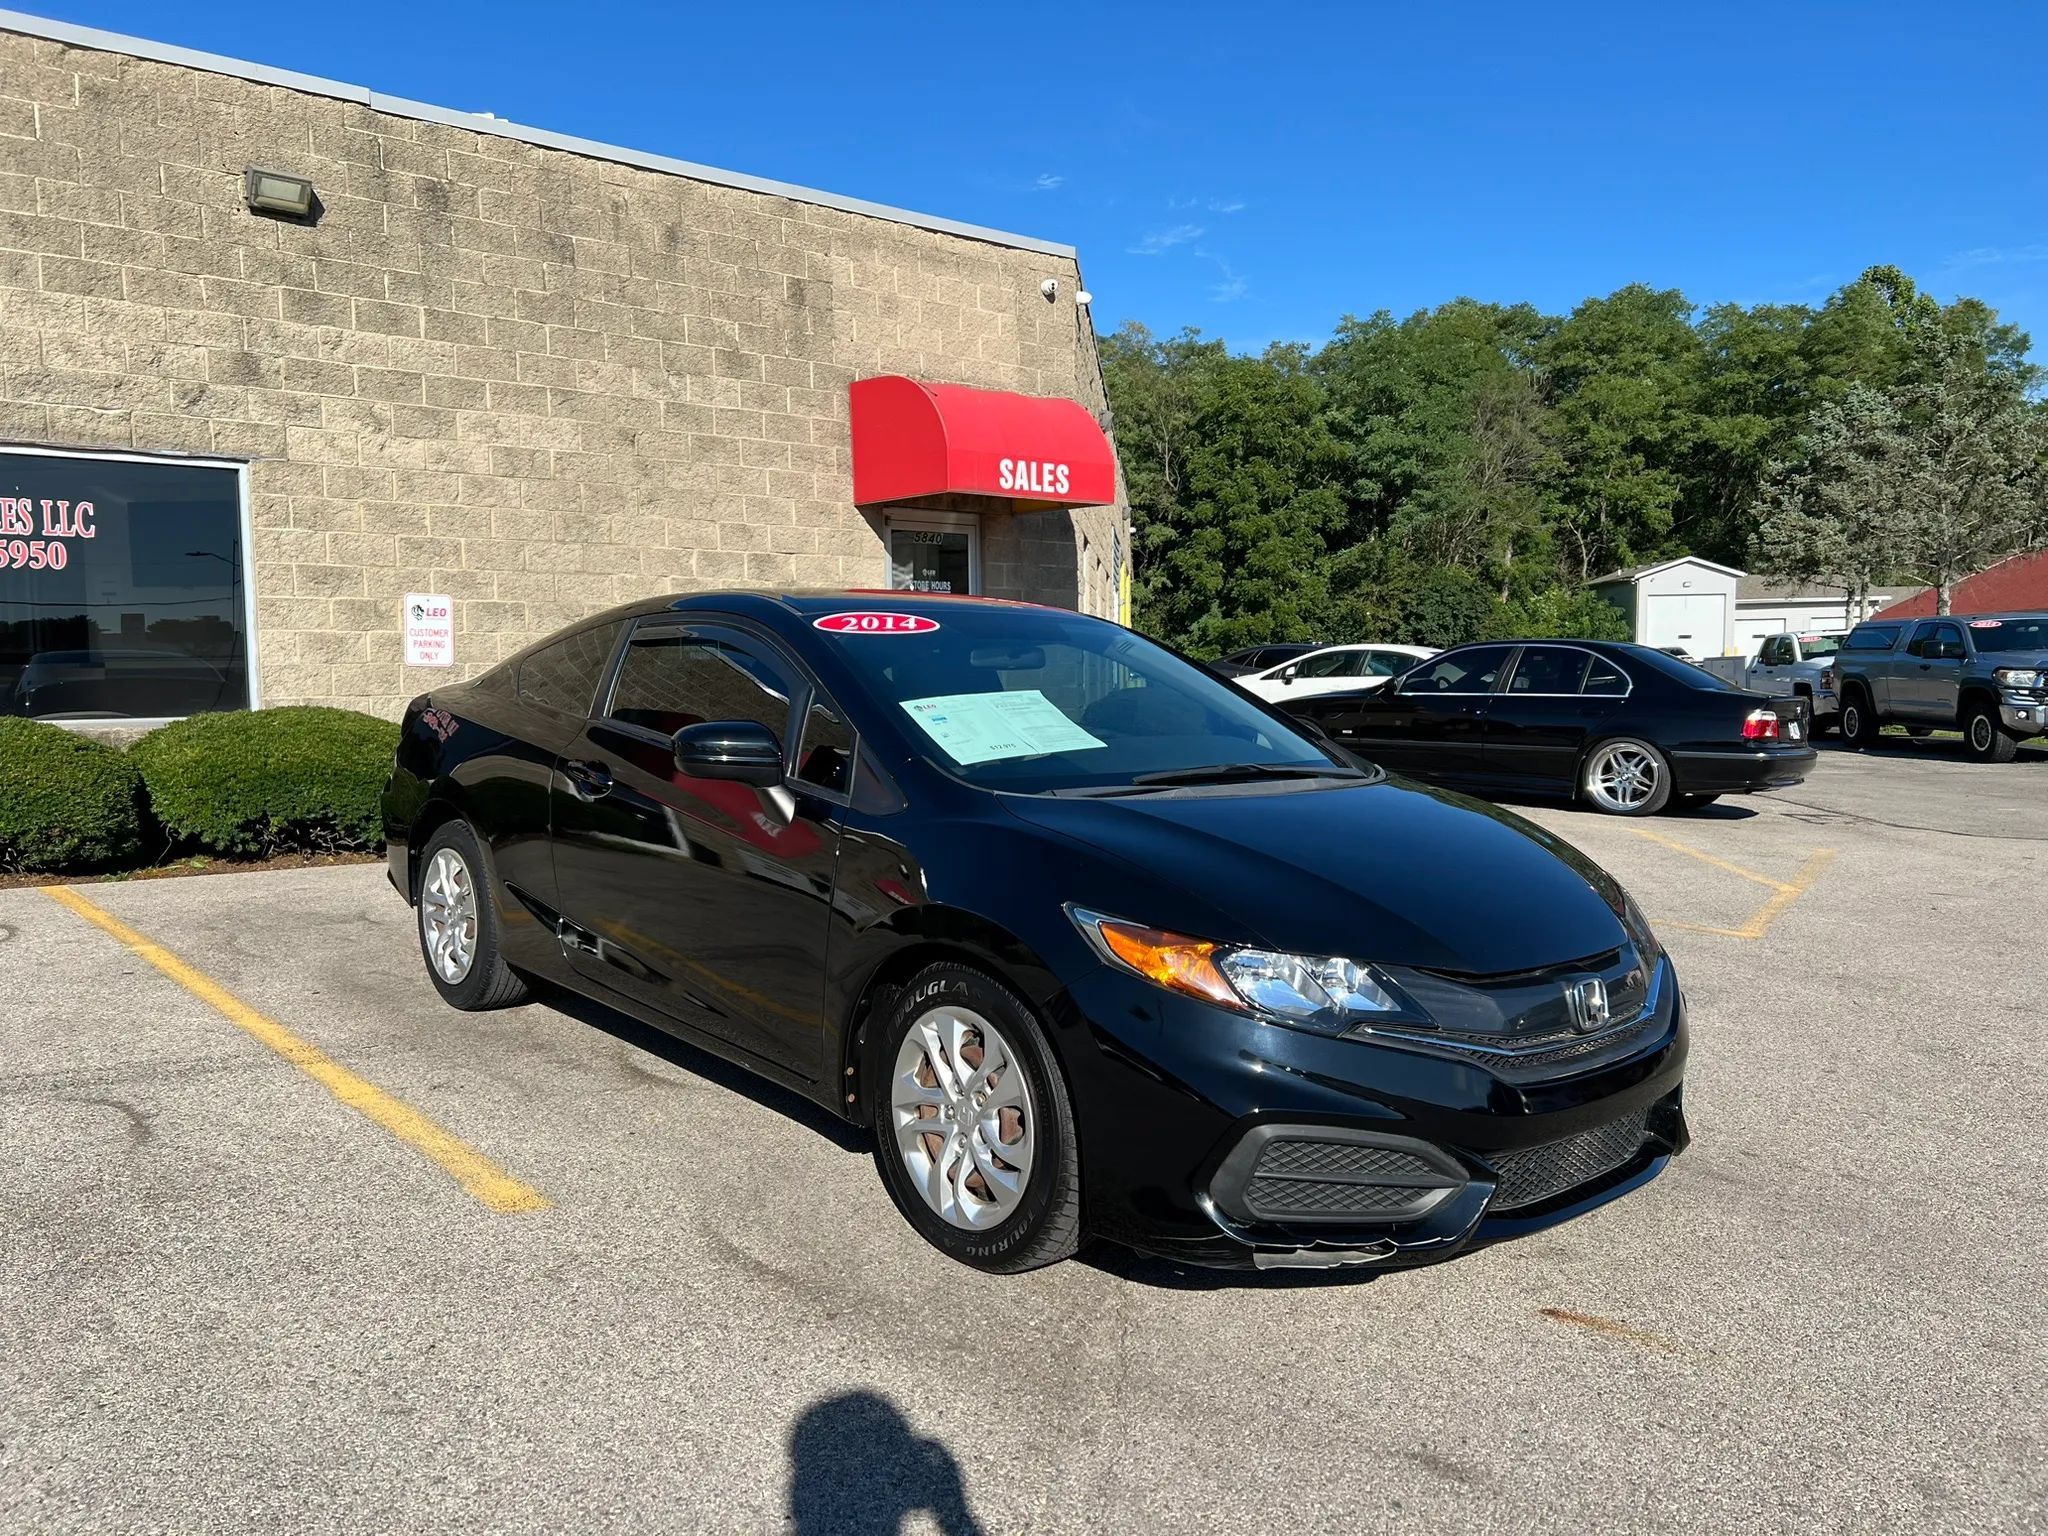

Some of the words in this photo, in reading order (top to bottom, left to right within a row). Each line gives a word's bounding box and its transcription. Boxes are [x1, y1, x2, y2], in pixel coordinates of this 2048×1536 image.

[999, 458, 1069, 494] SALES
[0, 497, 33, 536] ES
[40, 499, 96, 538] LLC
[914, 532, 942, 544] 5840
[931, 581, 952, 591] HOURS
[426, 608, 447, 617] LEO
[840, 615, 918, 631] 2014
[409, 628, 449, 637] CUSTOMER
[413, 640, 446, 648] PARKING
[420, 651, 439, 660] ONLY
[965, 1208, 1036, 1257] TOURING
